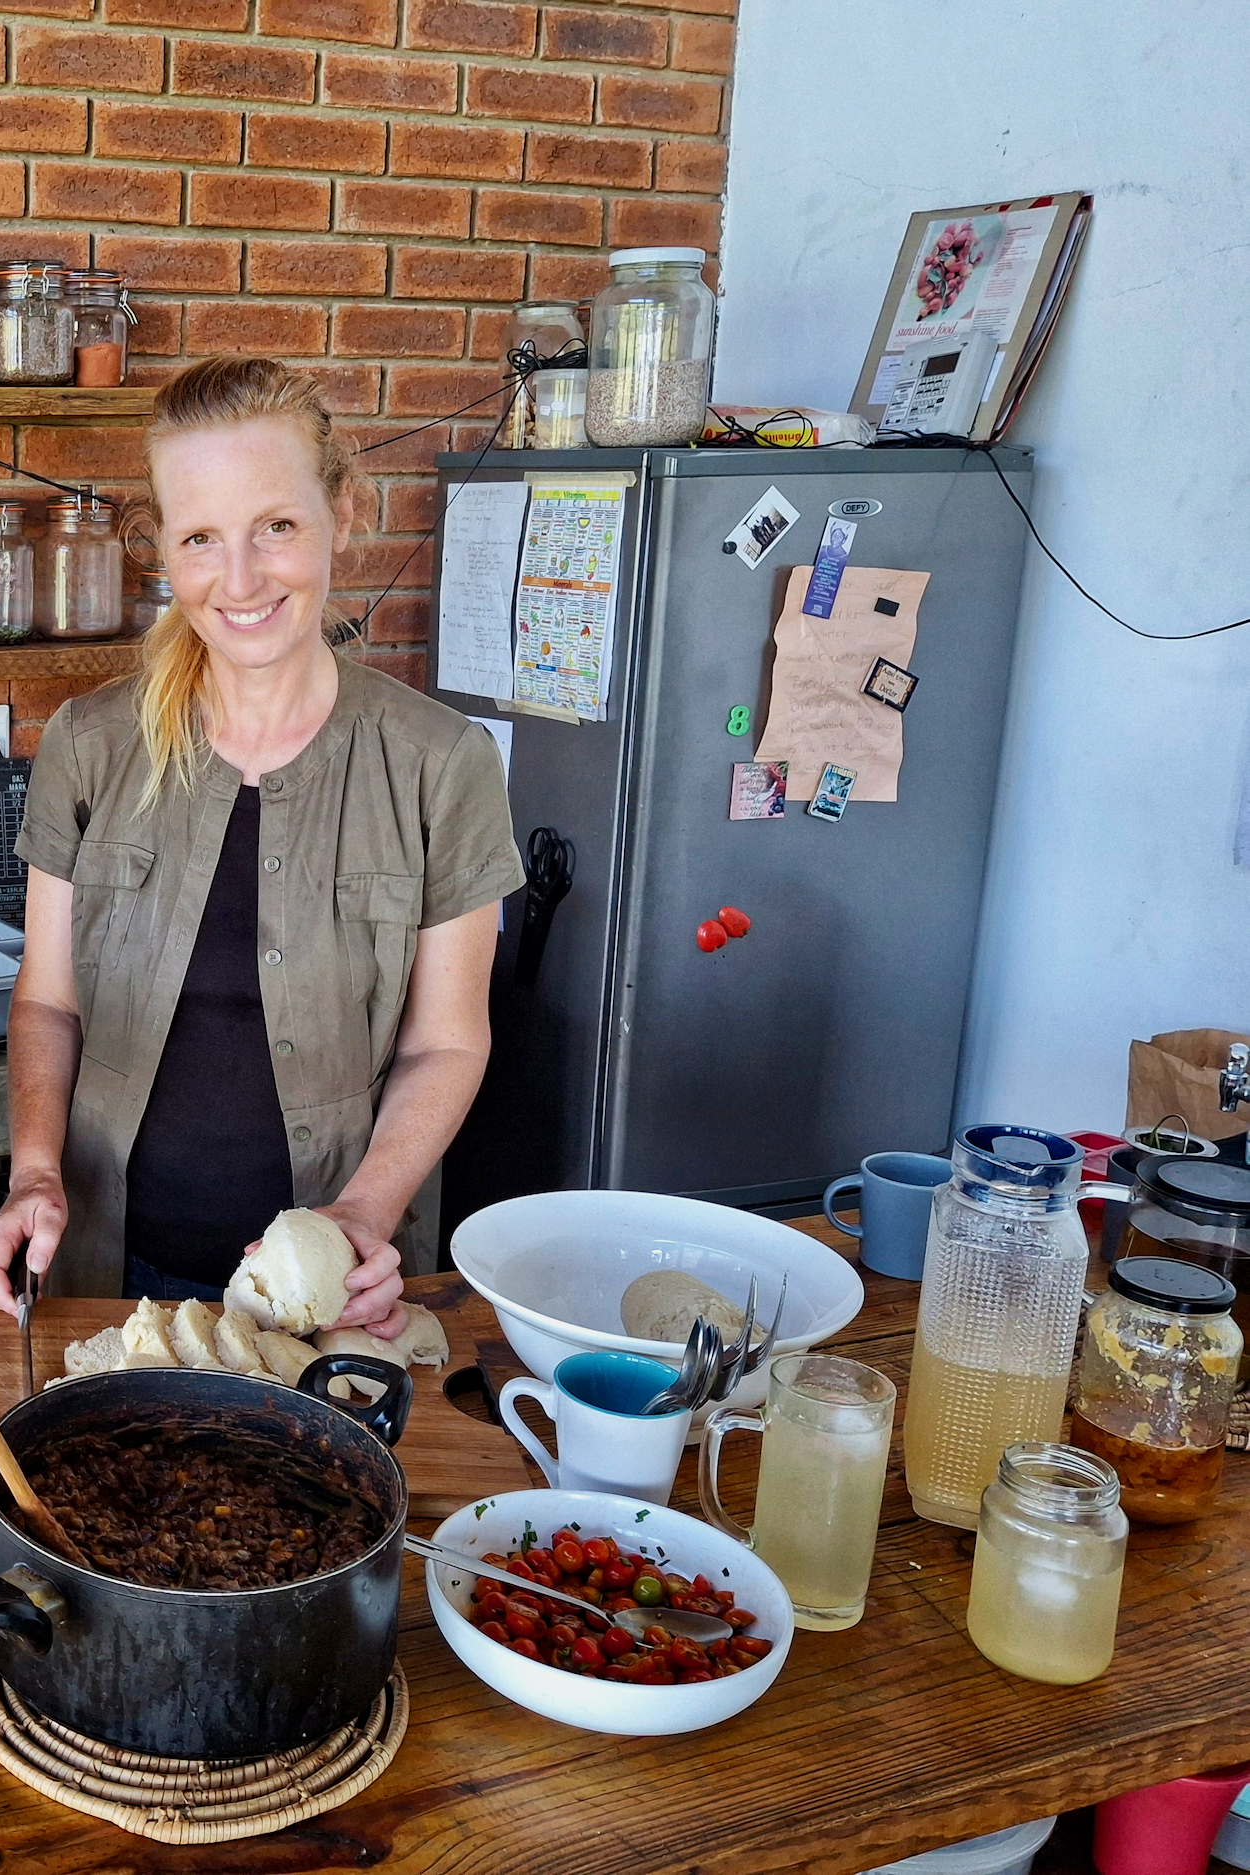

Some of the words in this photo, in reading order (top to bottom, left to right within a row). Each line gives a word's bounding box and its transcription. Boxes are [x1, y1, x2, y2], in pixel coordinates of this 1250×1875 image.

[896, 322, 936, 337] sunshine
[931, 320, 959, 338] food
[845, 503, 867, 513] DEFY
[727, 704, 751, 736] 8
[8, 783, 27, 792] MARK
